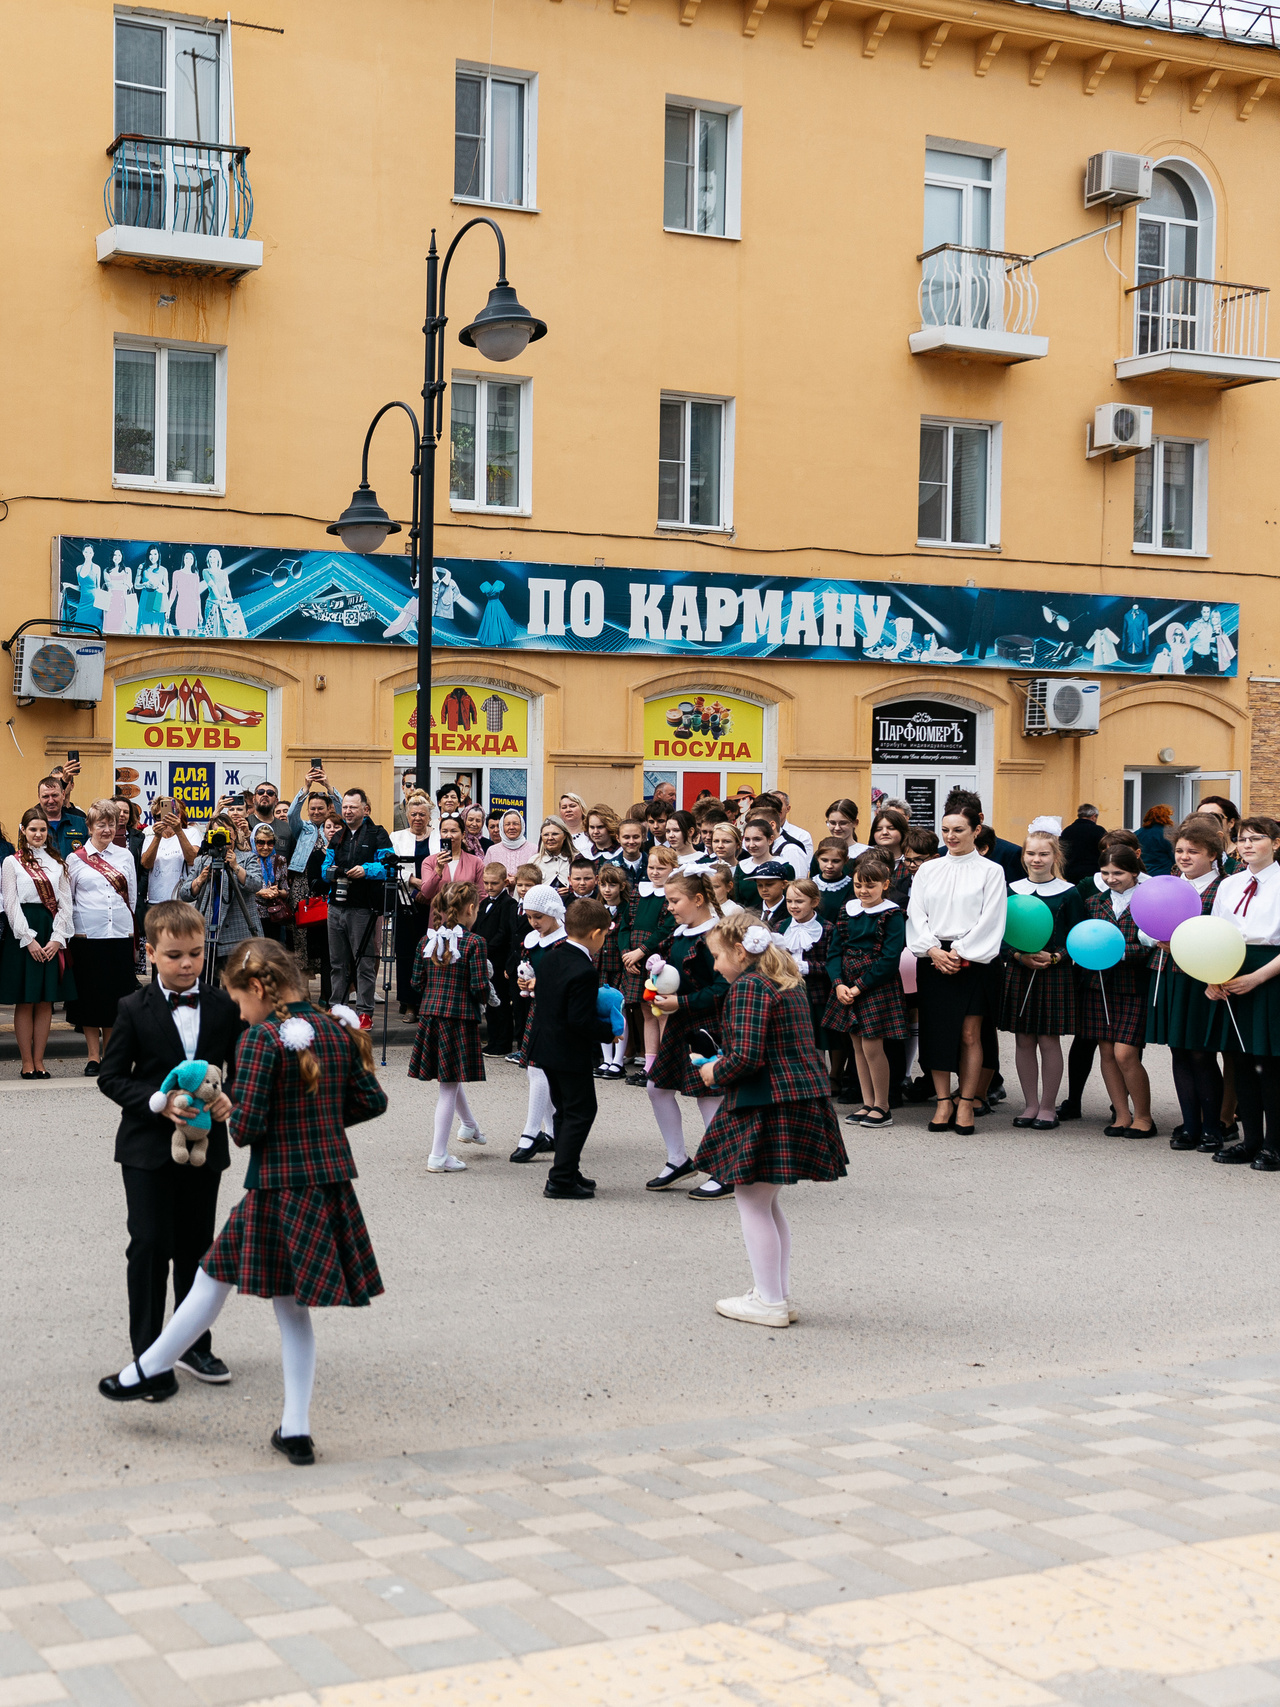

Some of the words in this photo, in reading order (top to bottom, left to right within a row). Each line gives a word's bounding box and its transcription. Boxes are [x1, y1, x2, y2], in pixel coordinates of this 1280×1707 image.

[527, 577, 606, 638] ПО
[628, 582, 891, 648] КАРМАНУ
[144, 726, 241, 748] ОБУВЬ
[654, 740, 752, 760] ПОСУДА
[173, 767, 207, 784] ДЛЯ
[173, 783, 210, 801] ВСЕЙ
[491, 797, 524, 807] СТИЛЬНАЯ
[185, 806, 213, 819] МЬИ
